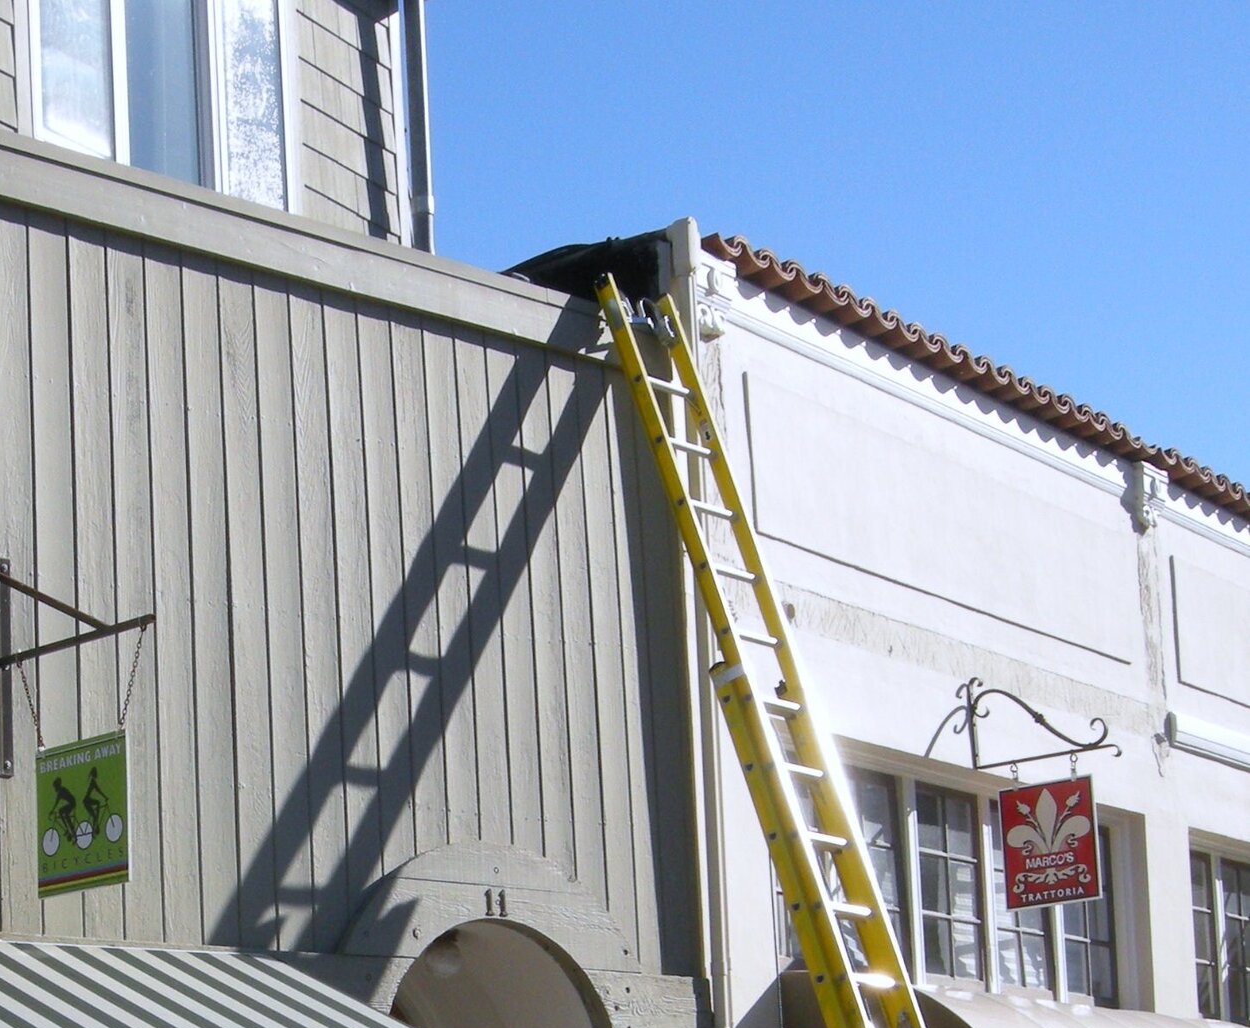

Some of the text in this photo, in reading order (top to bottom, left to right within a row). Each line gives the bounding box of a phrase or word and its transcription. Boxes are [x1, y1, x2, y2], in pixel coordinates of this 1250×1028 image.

[40, 744, 121, 773] BREAKING AWAY
[41, 847, 124, 873] BICYCLES
[1025, 852, 1074, 869] MARCO'S
[484, 888, 508, 917] 11
[1021, 887, 1085, 902] TRATTORIA
